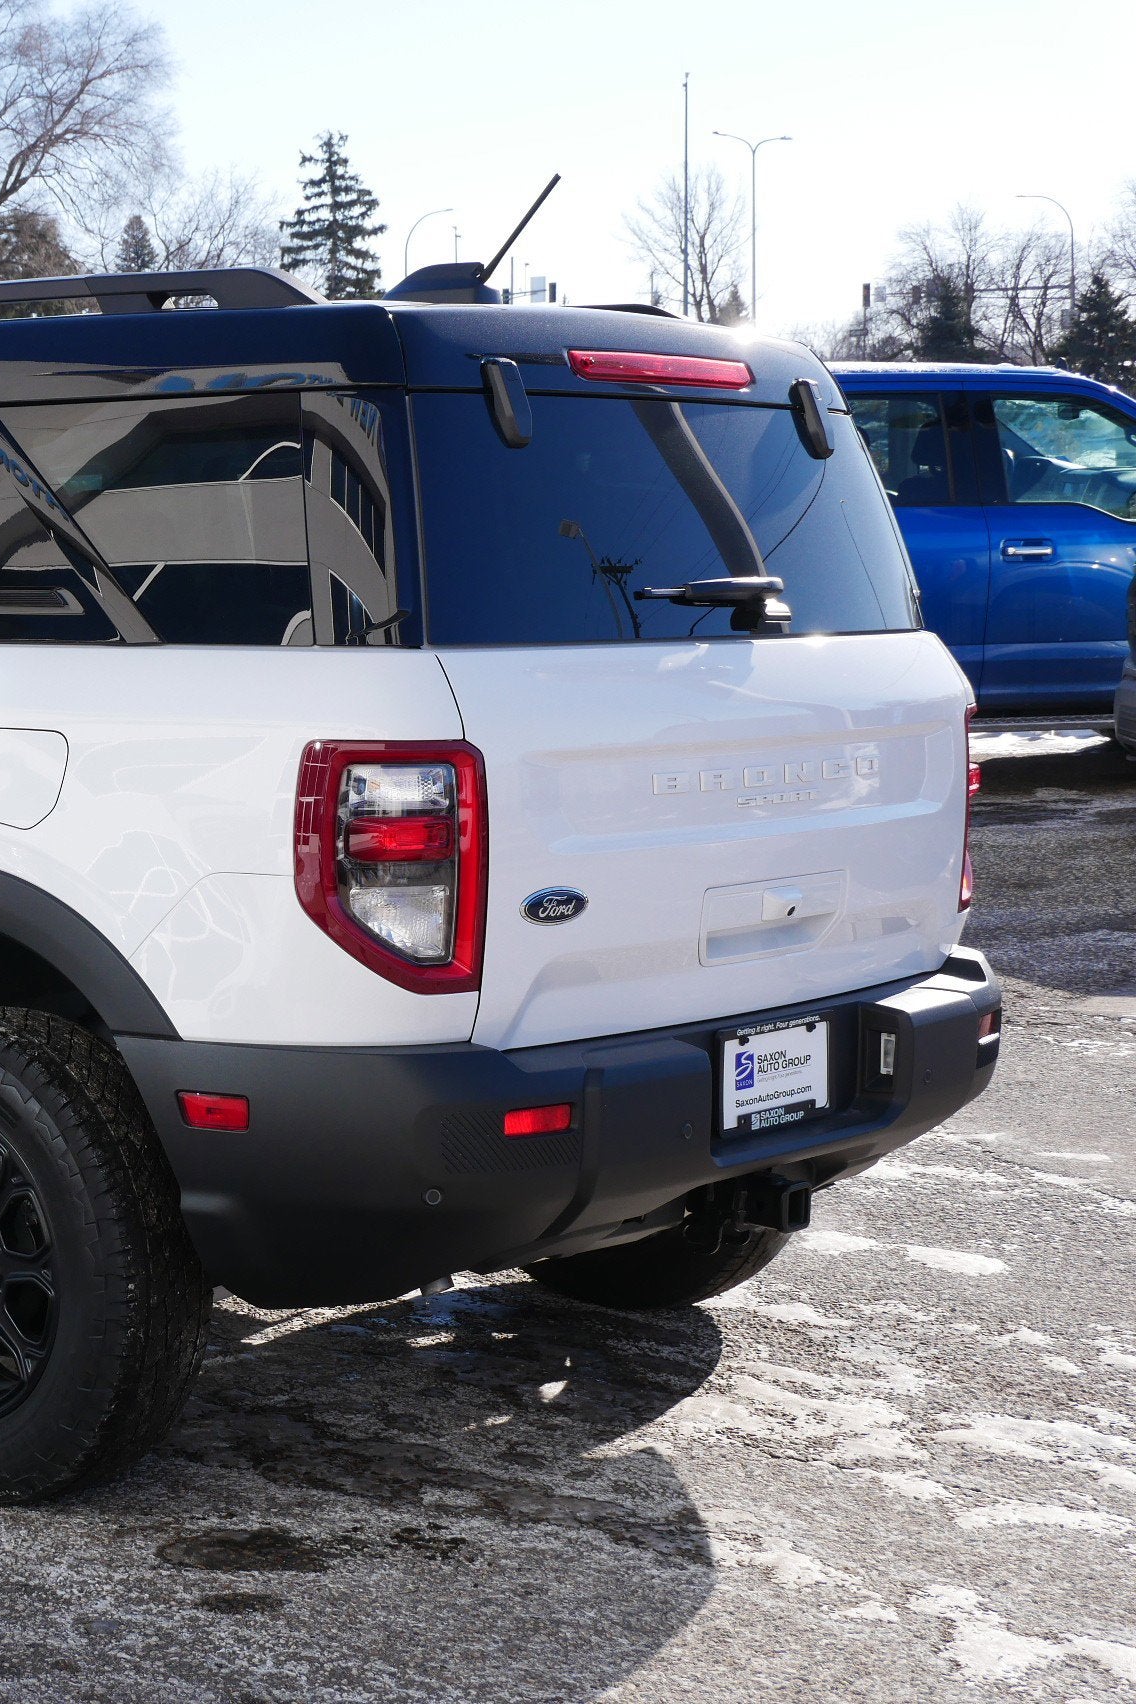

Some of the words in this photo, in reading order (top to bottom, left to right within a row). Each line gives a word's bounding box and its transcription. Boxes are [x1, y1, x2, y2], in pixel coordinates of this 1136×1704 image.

[652, 755, 879, 795] BRONCO
[737, 789, 816, 808] SPORT
[538, 895, 576, 919] Ford
[737, 1027, 755, 1036] Getting
[757, 1050, 787, 1065] SAXON
[757, 1062, 780, 1074] AUTO
[781, 1054, 812, 1069] GROUP
[735, 1085, 812, 1108] SaxonAutoGroup.com
[760, 1107, 785, 1120] SAXON
[760, 1117, 779, 1128] AUTO
[780, 1110, 804, 1124] GROUP
